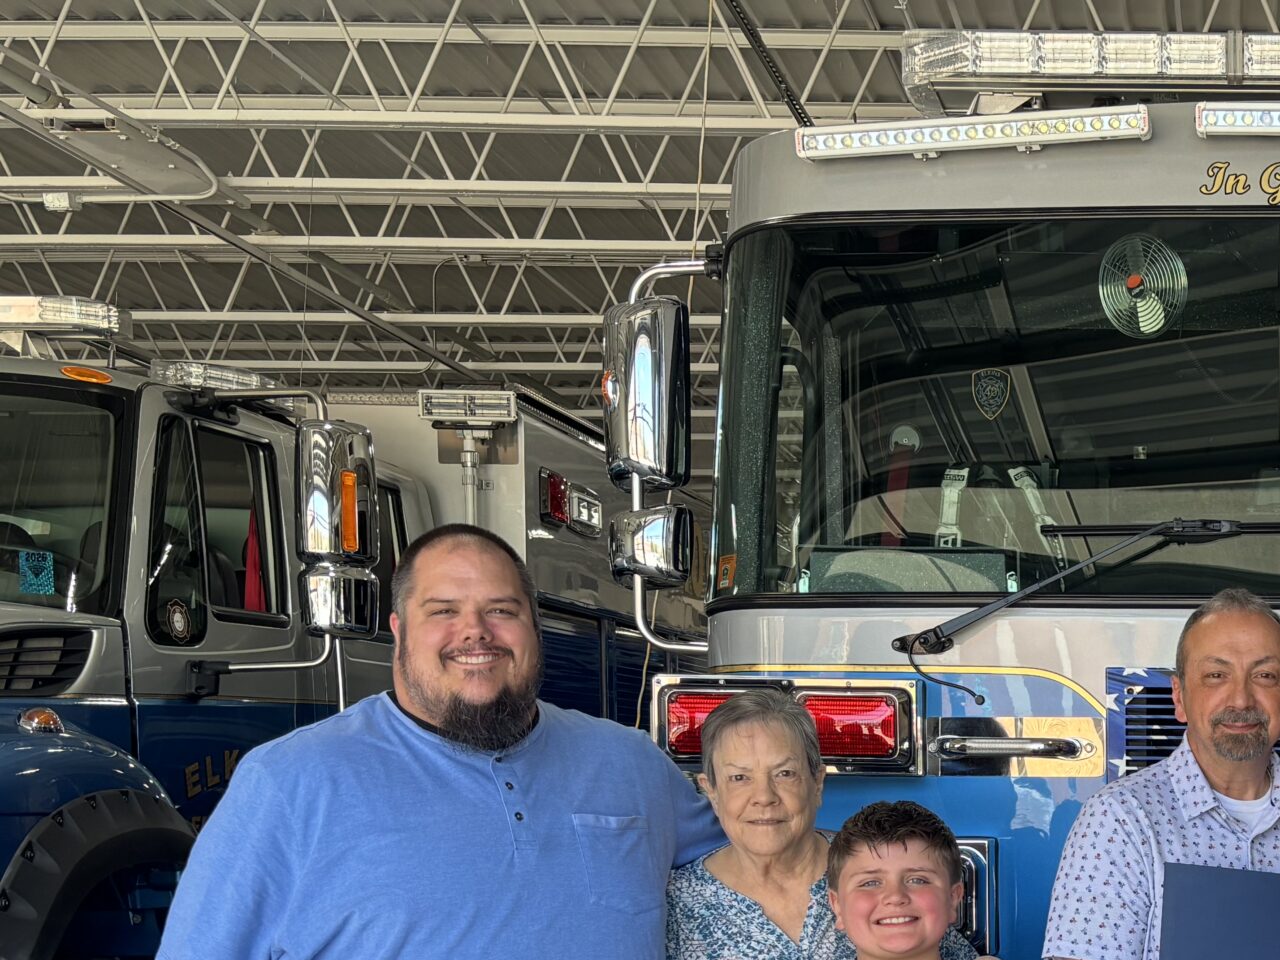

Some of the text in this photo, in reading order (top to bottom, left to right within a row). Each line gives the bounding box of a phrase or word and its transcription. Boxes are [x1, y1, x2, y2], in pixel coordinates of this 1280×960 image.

[1199, 161, 1251, 196] In
[25, 552, 48, 562] 2026
[185, 749, 241, 798] ELK
